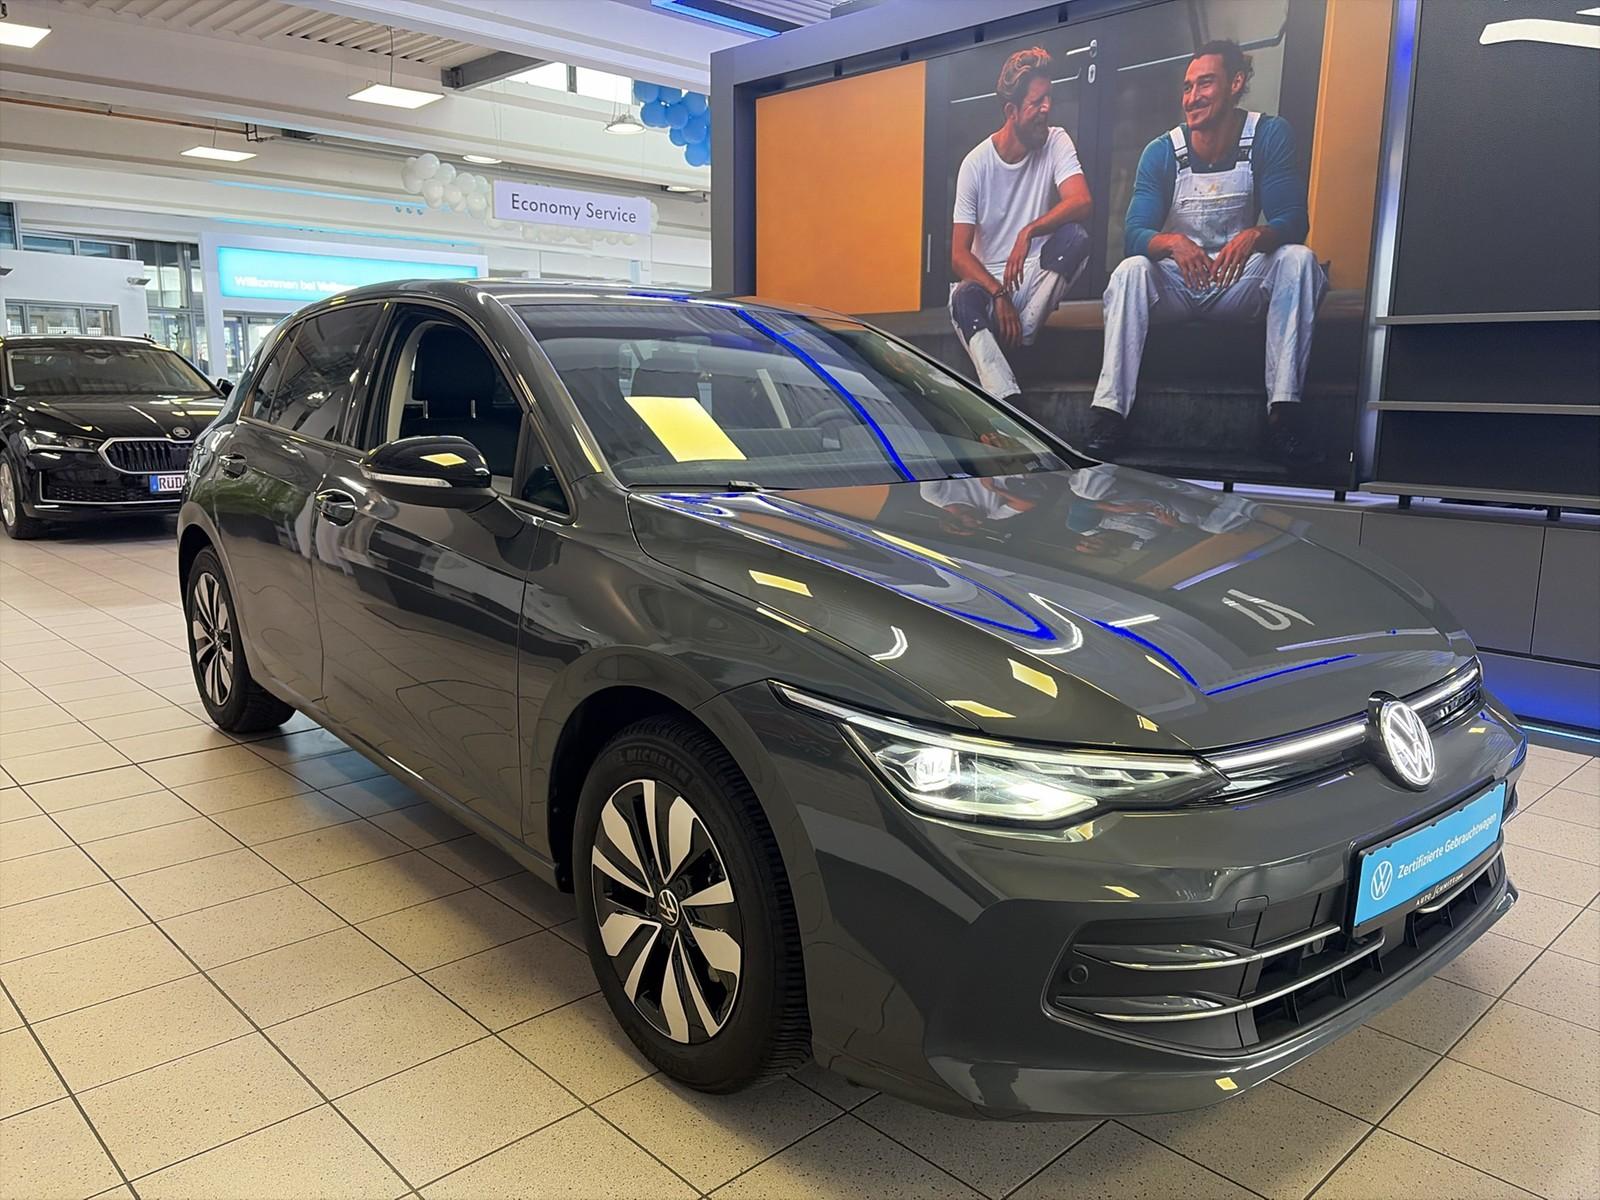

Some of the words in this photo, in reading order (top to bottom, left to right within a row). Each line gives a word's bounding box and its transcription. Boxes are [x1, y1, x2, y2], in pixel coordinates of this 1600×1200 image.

[511, 193, 581, 220] Economy
[586, 202, 637, 223] Service
[235, 276, 297, 291] Willkommen
[159, 477, 182, 489] RÜD
[626, 748, 690, 782] MICHELIN
[1397, 846, 1444, 879] Zertifizierte
[1444, 813, 1497, 853] Gebrauchtwagen
